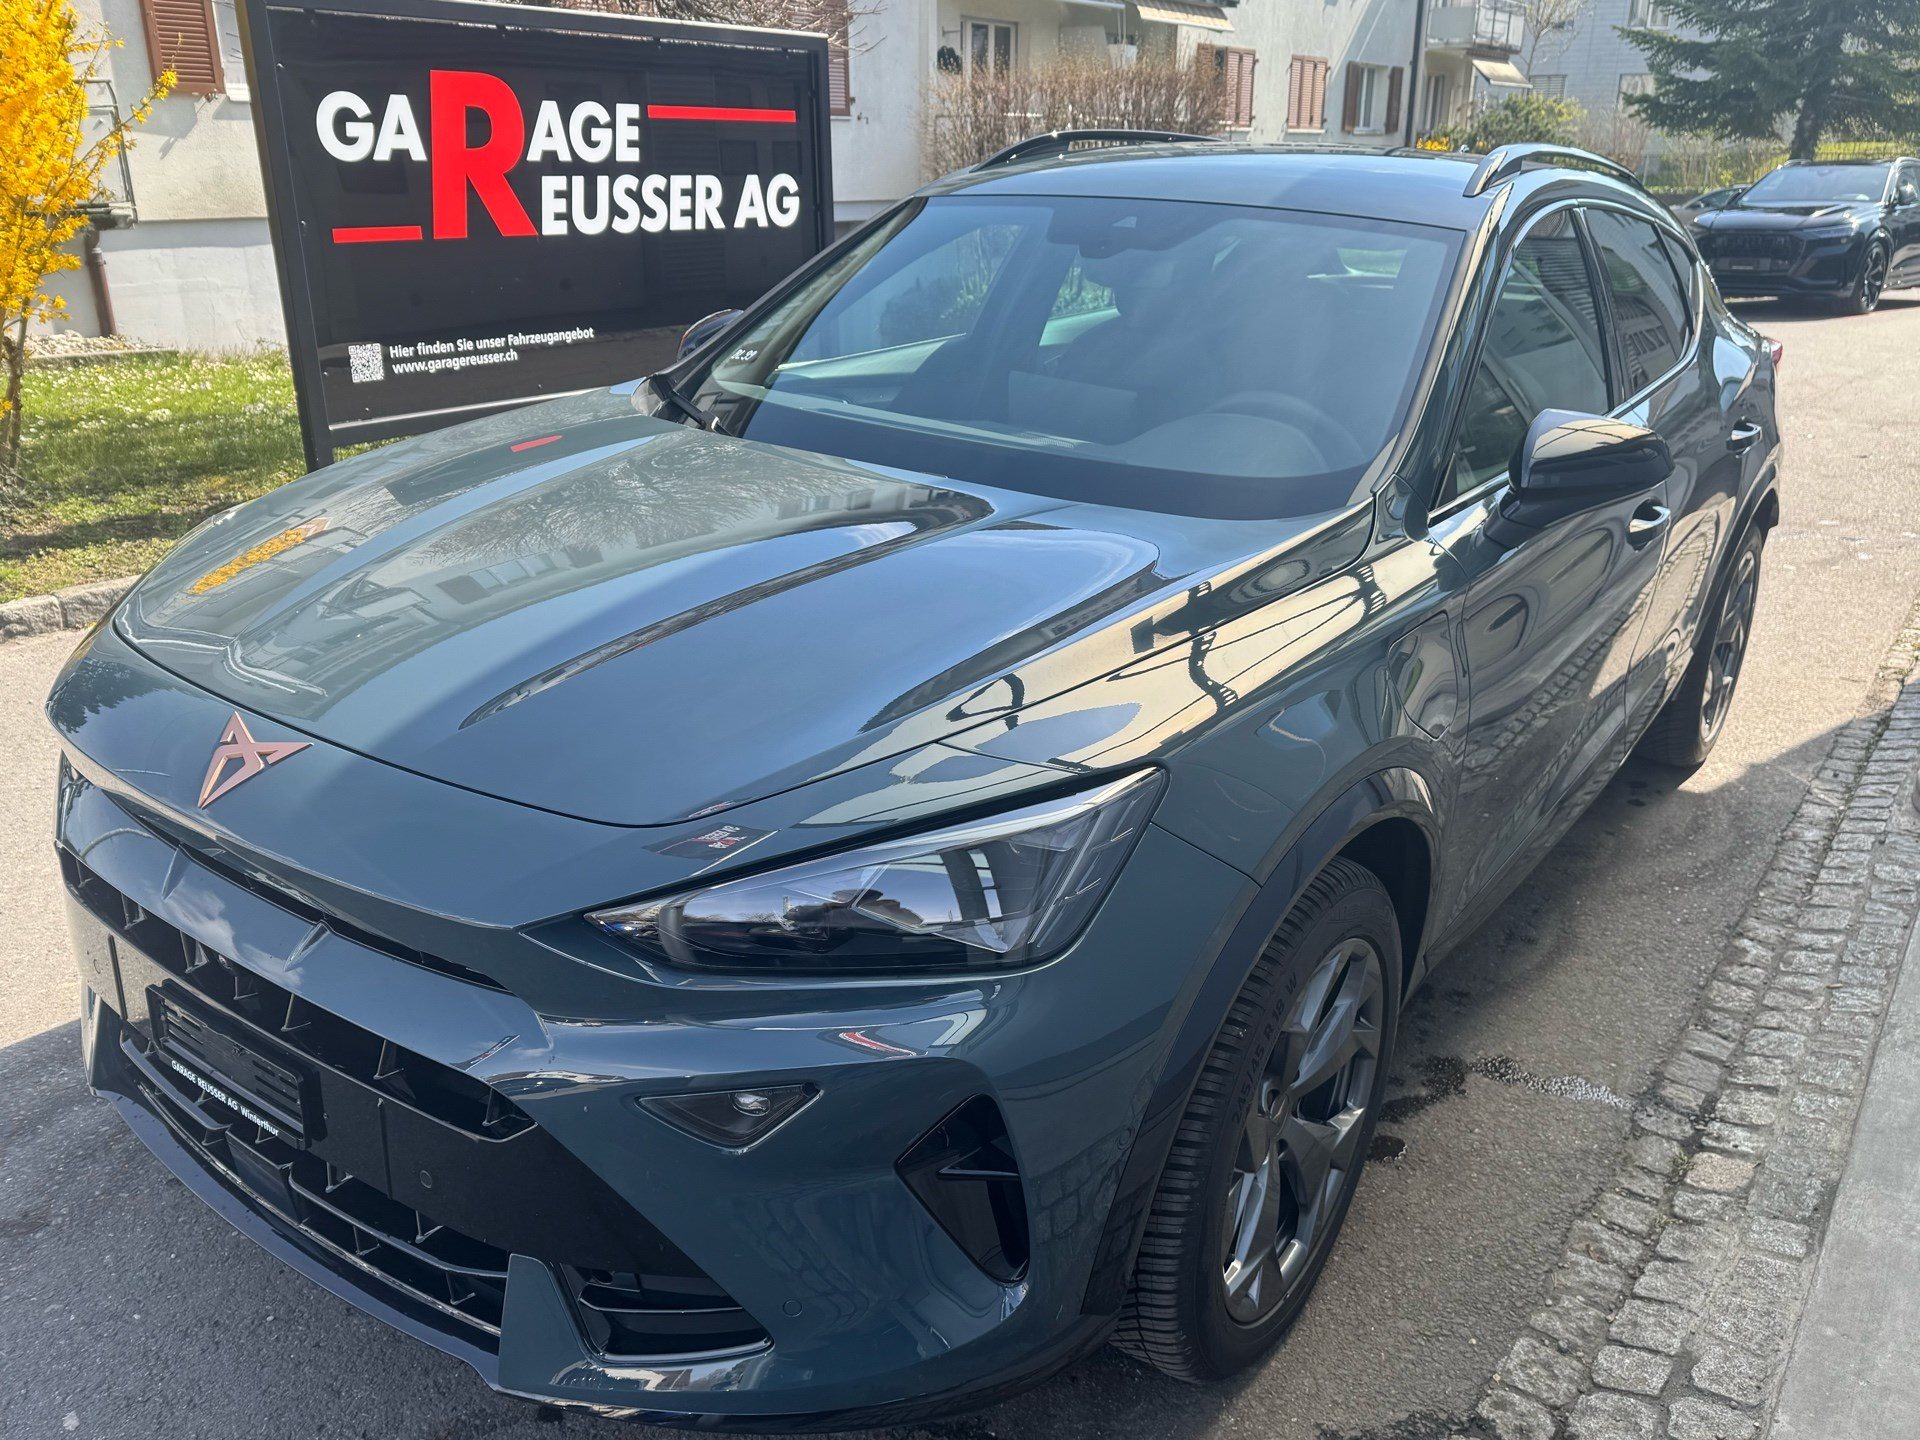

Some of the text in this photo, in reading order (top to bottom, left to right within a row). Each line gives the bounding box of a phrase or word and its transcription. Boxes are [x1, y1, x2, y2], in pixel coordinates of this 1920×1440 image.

[733, 173, 800, 229] AG
[389, 326, 595, 358] Hier finden Sie unser Fahrzeugangebot
[392, 349, 518, 374] www.garagereusser.ch
[171, 1060, 279, 1137] GARAGE REUSSER AG Winterthur
